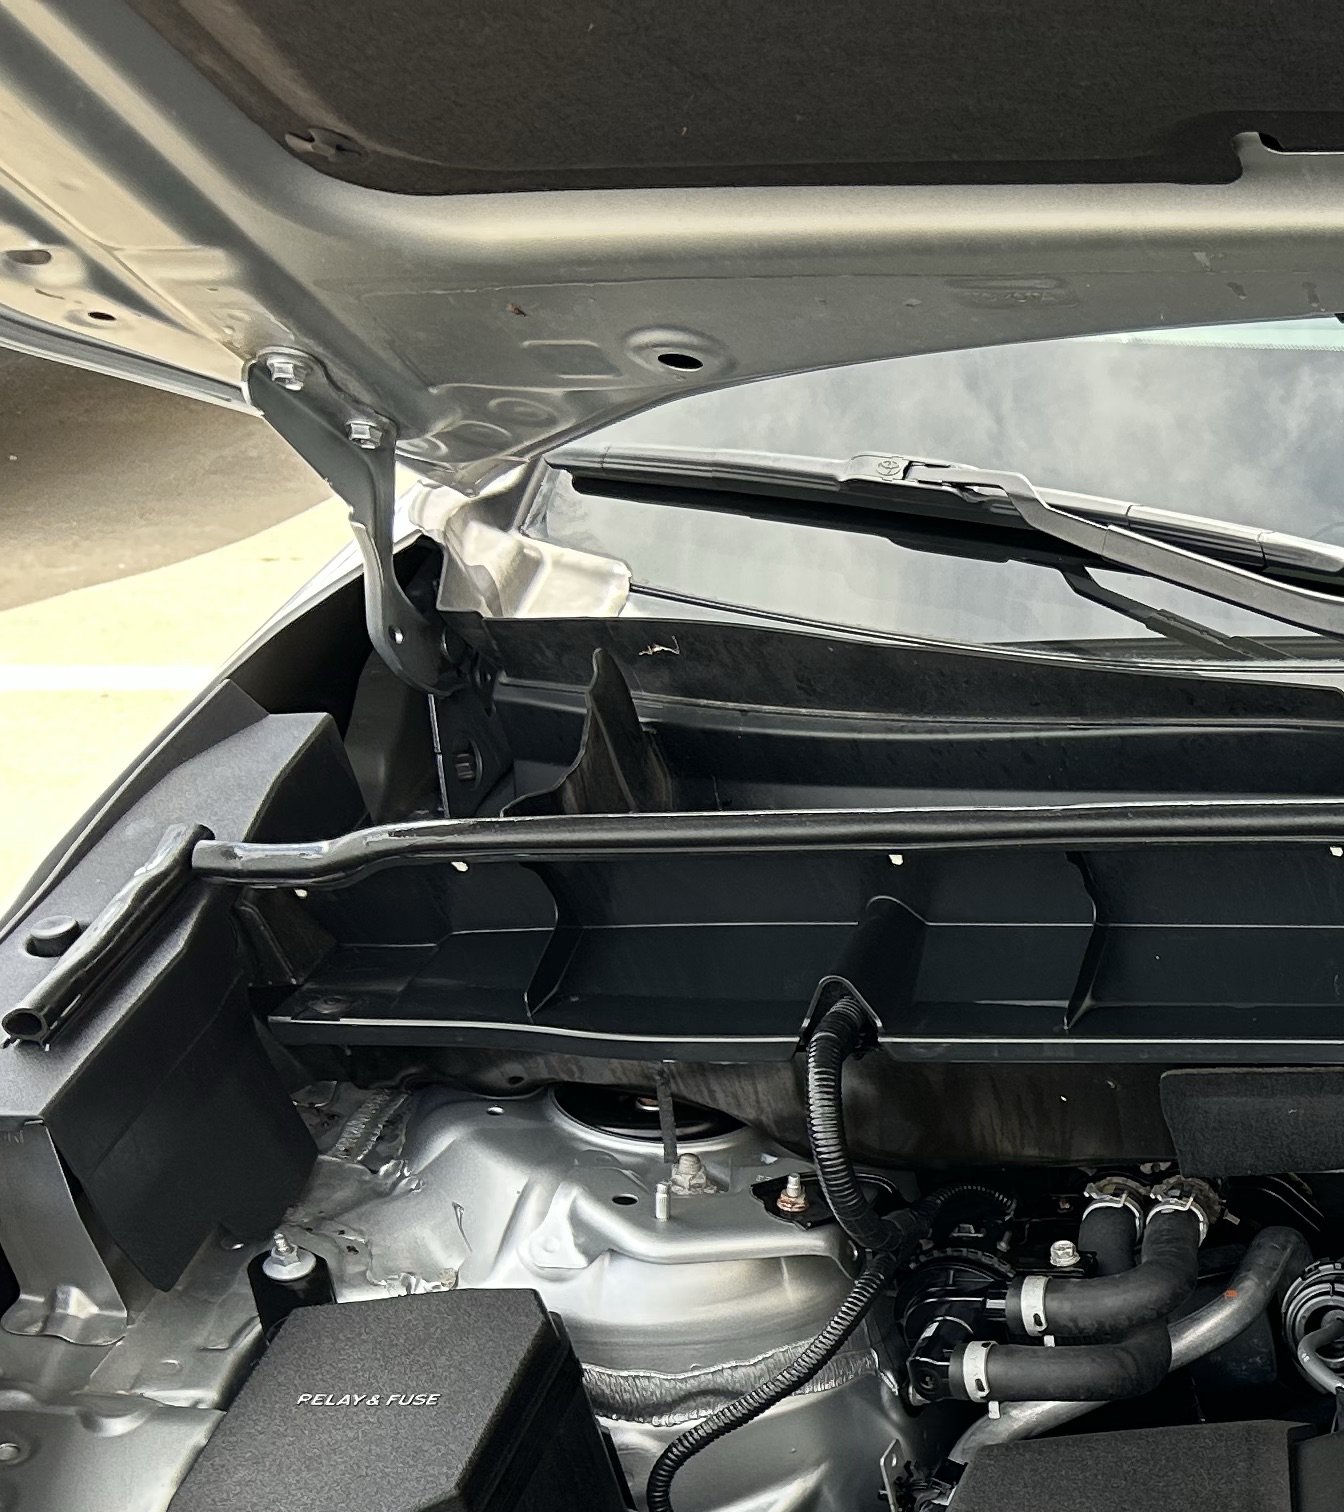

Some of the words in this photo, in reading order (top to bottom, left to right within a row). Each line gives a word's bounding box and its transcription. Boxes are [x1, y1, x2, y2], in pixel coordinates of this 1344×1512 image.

[297, 1393, 366, 1407] RELAY
[365, 1393, 382, 1407] &
[385, 1393, 442, 1407] FUSE
